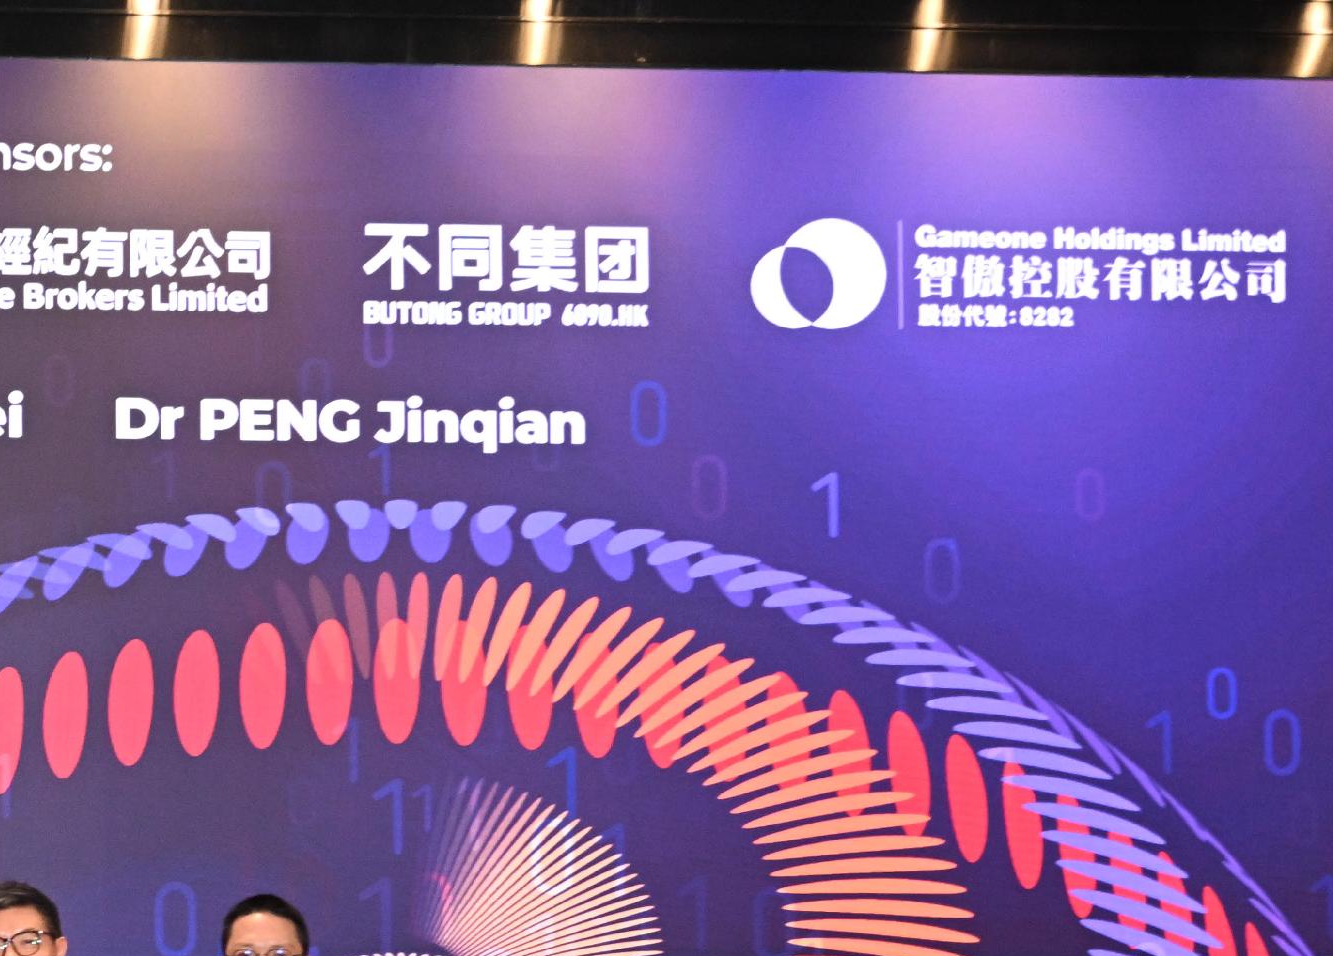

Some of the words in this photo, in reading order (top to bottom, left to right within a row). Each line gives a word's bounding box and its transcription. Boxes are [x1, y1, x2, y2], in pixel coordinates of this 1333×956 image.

[914, 224, 1047, 249] Gameone
[1053, 227, 1175, 255] Holdings
[1181, 229, 1287, 253] Limited
[362, 222, 650, 294] 不同集团
[23, 282, 145, 311] Brokers
[151, 283, 268, 313] Limited
[362, 300, 463, 326] BUTONG
[468, 302, 552, 326] GROUP
[561, 303, 650, 328] 6090.HK
[115, 397, 185, 440] Dr
[200, 398, 360, 443] PENG
[374, 396, 586, 454] Jinqian
